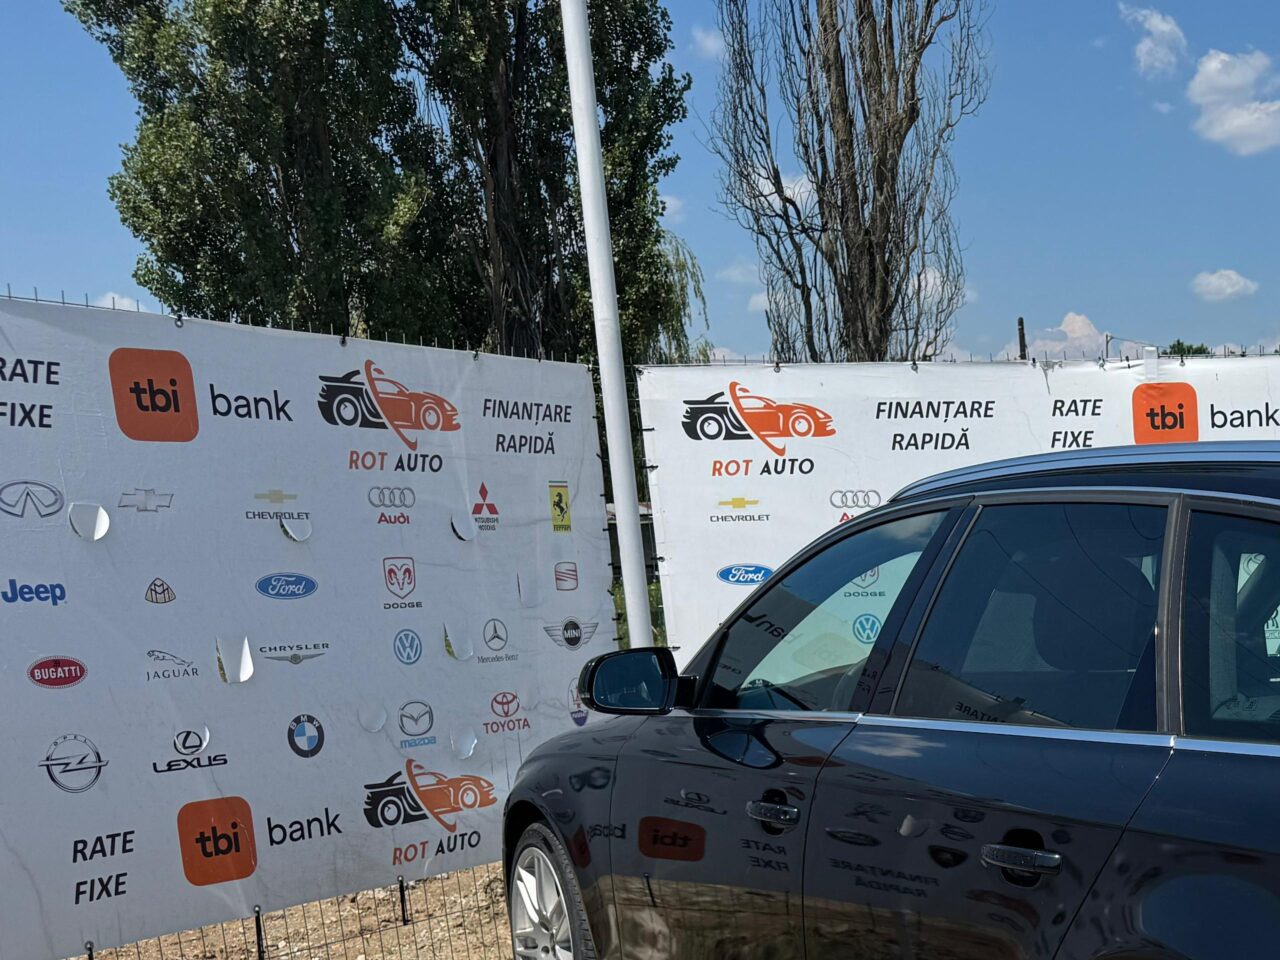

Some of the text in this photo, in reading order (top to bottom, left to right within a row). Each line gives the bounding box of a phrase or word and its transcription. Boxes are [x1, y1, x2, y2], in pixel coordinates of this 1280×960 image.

[129, 378, 293, 422] tbi bank
[1052, 399, 1103, 417] RATE
[483, 398, 572, 425] FINANȚARE
[876, 400, 995, 423] FINANȚARE
[1146, 402, 1280, 430] tbi bank
[495, 432, 555, 455] RAPIDĂ
[892, 428, 970, 450] RAPIDĂ
[1051, 430, 1094, 448] FIXE
[349, 450, 443, 472] ROT AUTO
[711, 458, 815, 476] ROT AUTO
[245, 511, 312, 521] CHEVROLET
[377, 512, 410, 526] Audi
[710, 514, 771, 523] CHEVROLET
[729, 567, 764, 582] Ford
[1, 579, 67, 606] Jeep
[268, 576, 306, 596] Ford
[844, 590, 886, 598] DODGE
[383, 601, 423, 610] DODGE
[259, 642, 330, 653] CHRYSLER
[34, 665, 82, 681] BUGATTI
[146, 667, 200, 682] JAGUAR
[483, 718, 531, 734] TOYOTA
[400, 736, 437, 749] mazda
[152, 753, 229, 774] LEXUS
[195, 808, 342, 858] tbi bank
[72, 830, 135, 863] RATE
[392, 830, 481, 866] ROT AUTO
[75, 872, 127, 905] FIXE
